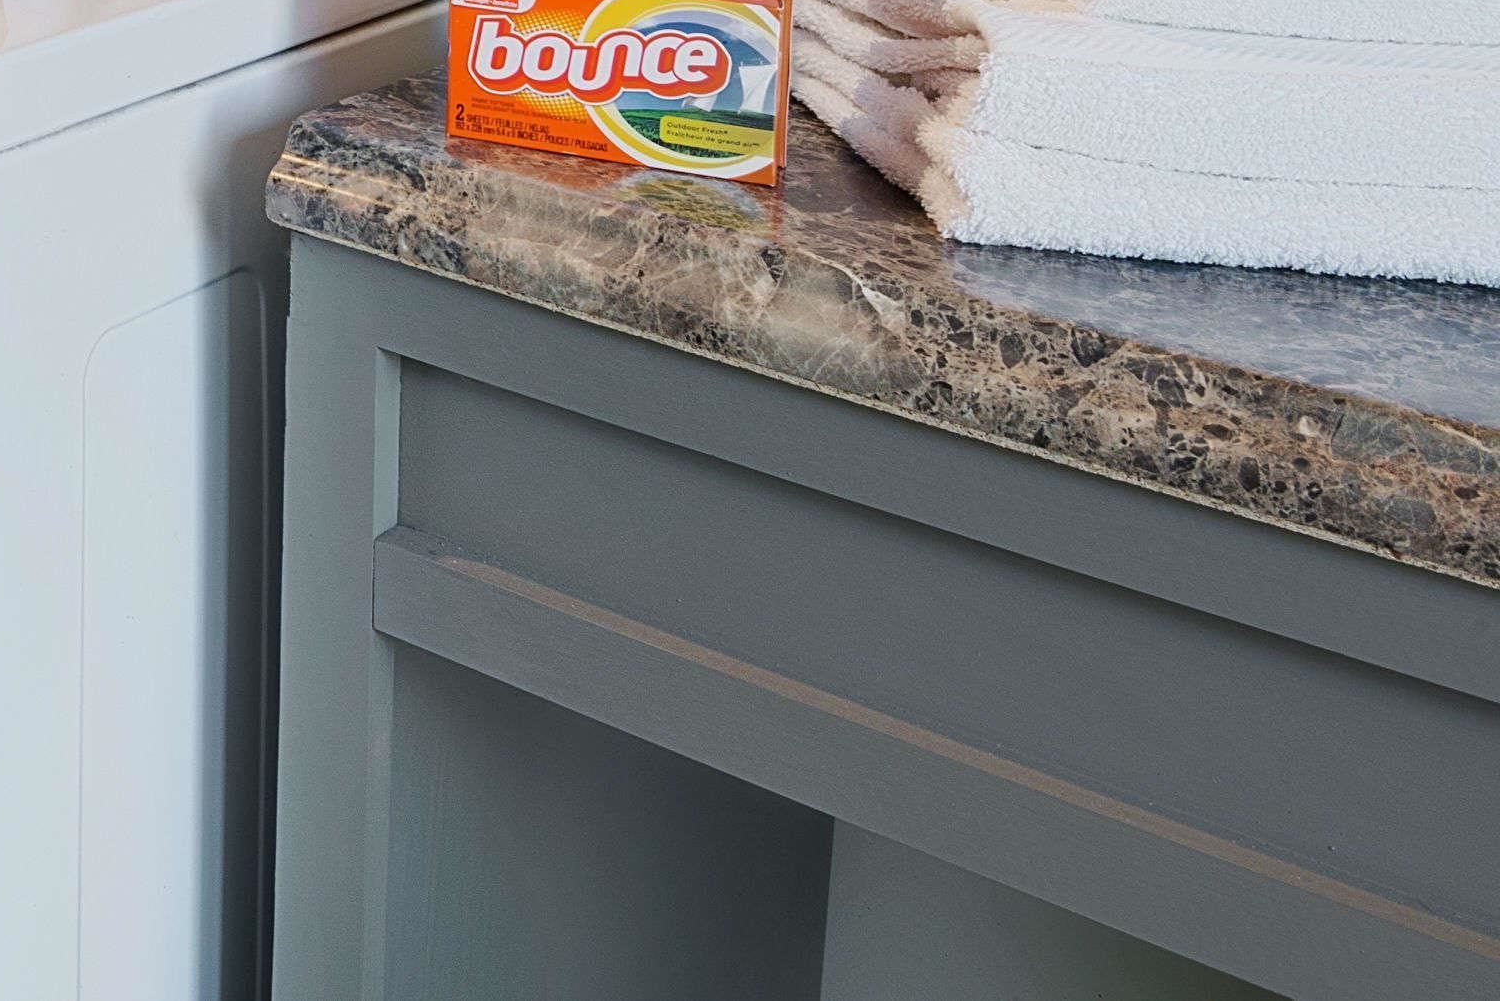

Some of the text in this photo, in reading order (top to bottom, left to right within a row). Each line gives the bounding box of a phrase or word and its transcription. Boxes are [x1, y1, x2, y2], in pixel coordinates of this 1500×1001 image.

[475, 19, 719, 91] bounce
[455, 103, 465, 121] 2
[466, 114, 491, 125] SHEETS
[666, 122, 700, 132] Outdoor
[717, 139, 741, 147] grand
